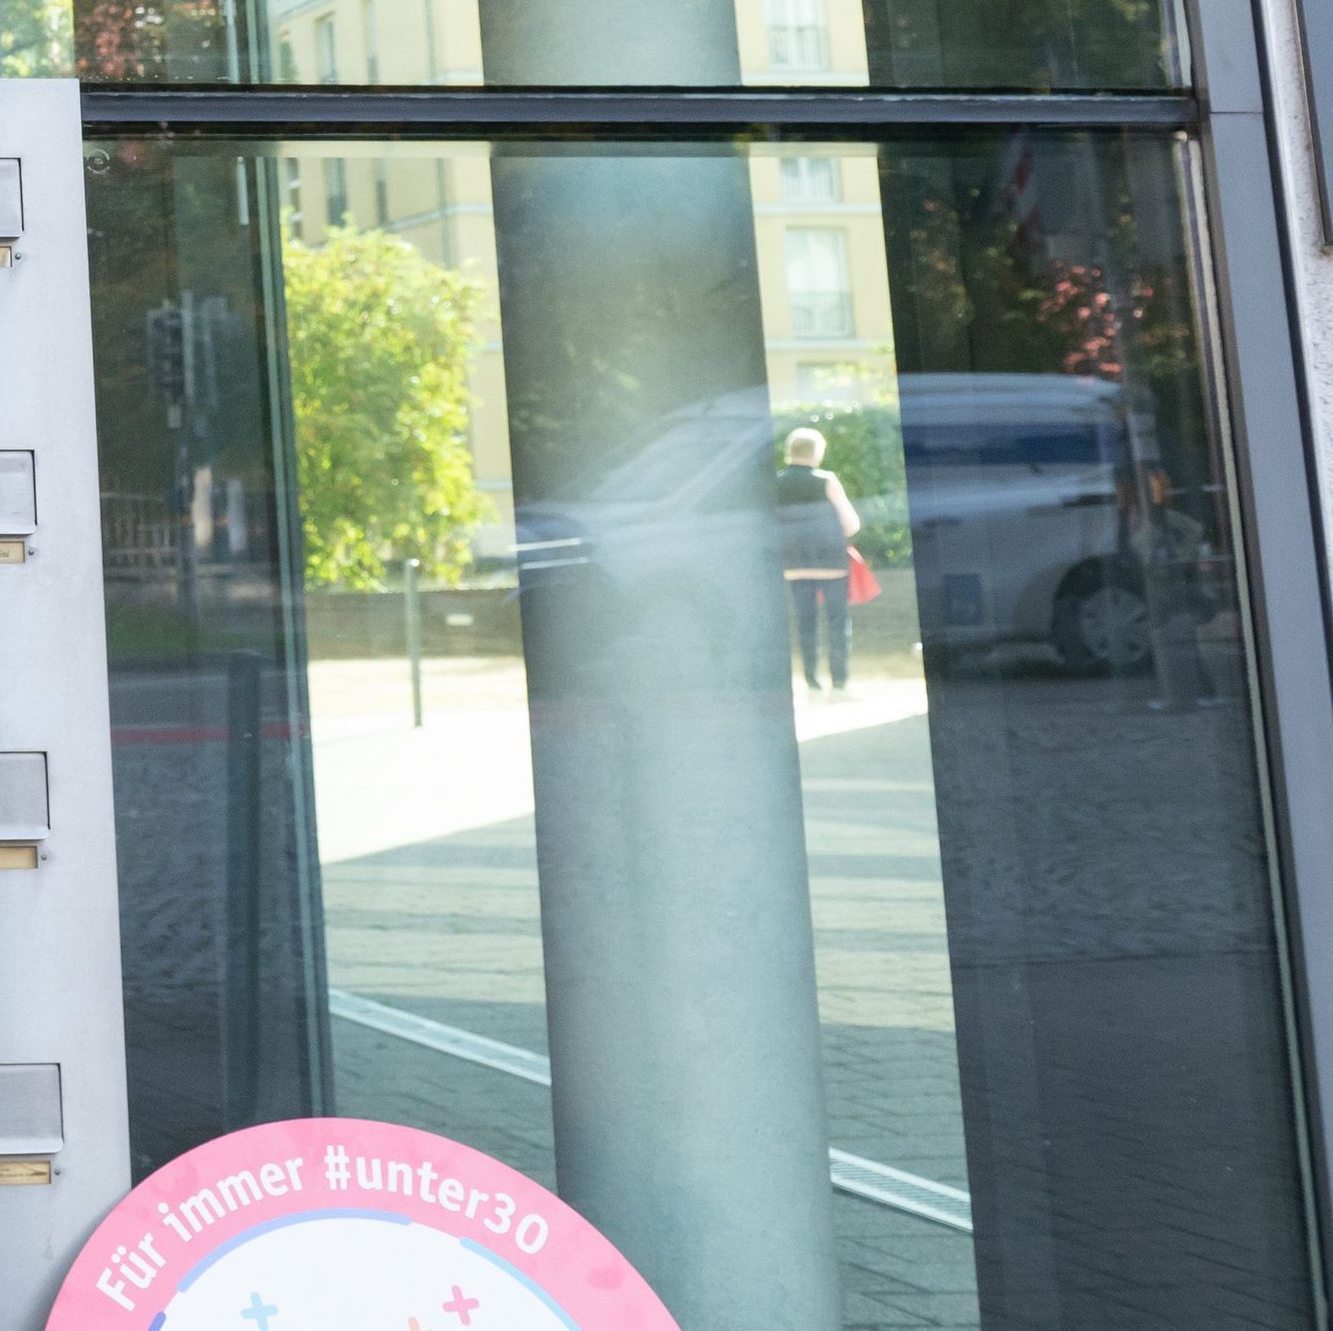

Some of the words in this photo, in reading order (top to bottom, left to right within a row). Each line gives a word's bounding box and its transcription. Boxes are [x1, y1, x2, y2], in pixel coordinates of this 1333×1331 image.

[95, 1232, 167, 1312] Für
[157, 1156, 304, 1243] immer
[323, 1143, 550, 1255] #unter30
